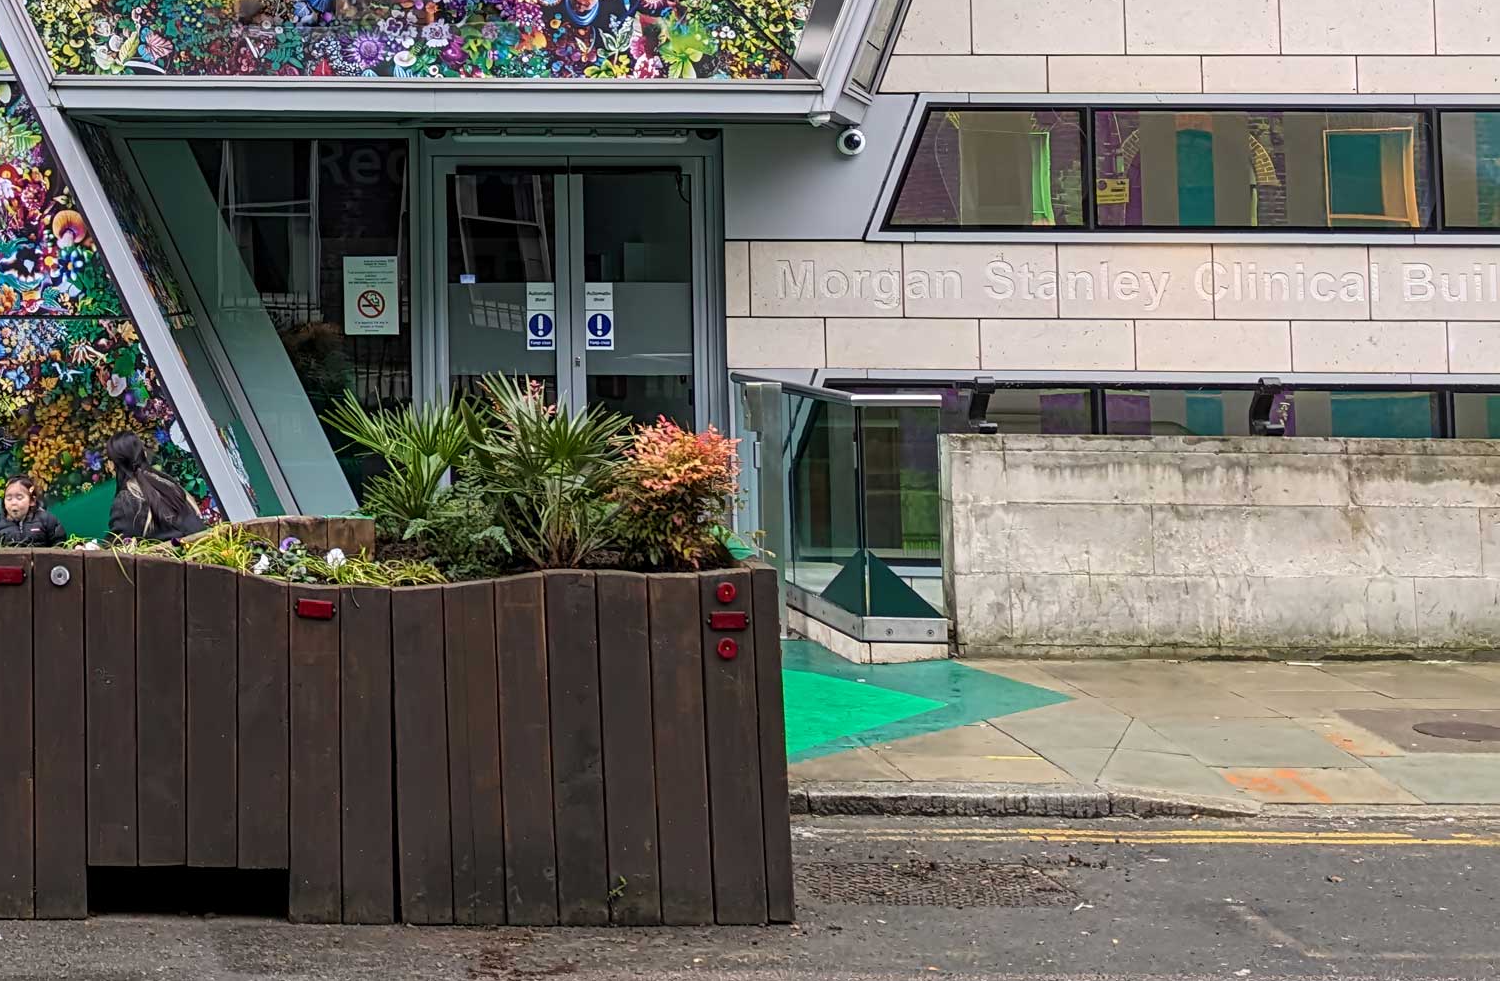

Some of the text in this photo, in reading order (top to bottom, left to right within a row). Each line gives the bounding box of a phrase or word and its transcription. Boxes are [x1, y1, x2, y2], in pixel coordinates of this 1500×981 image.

[775, 259, 1499, 311] Morgan Stanley Clinical Buil
